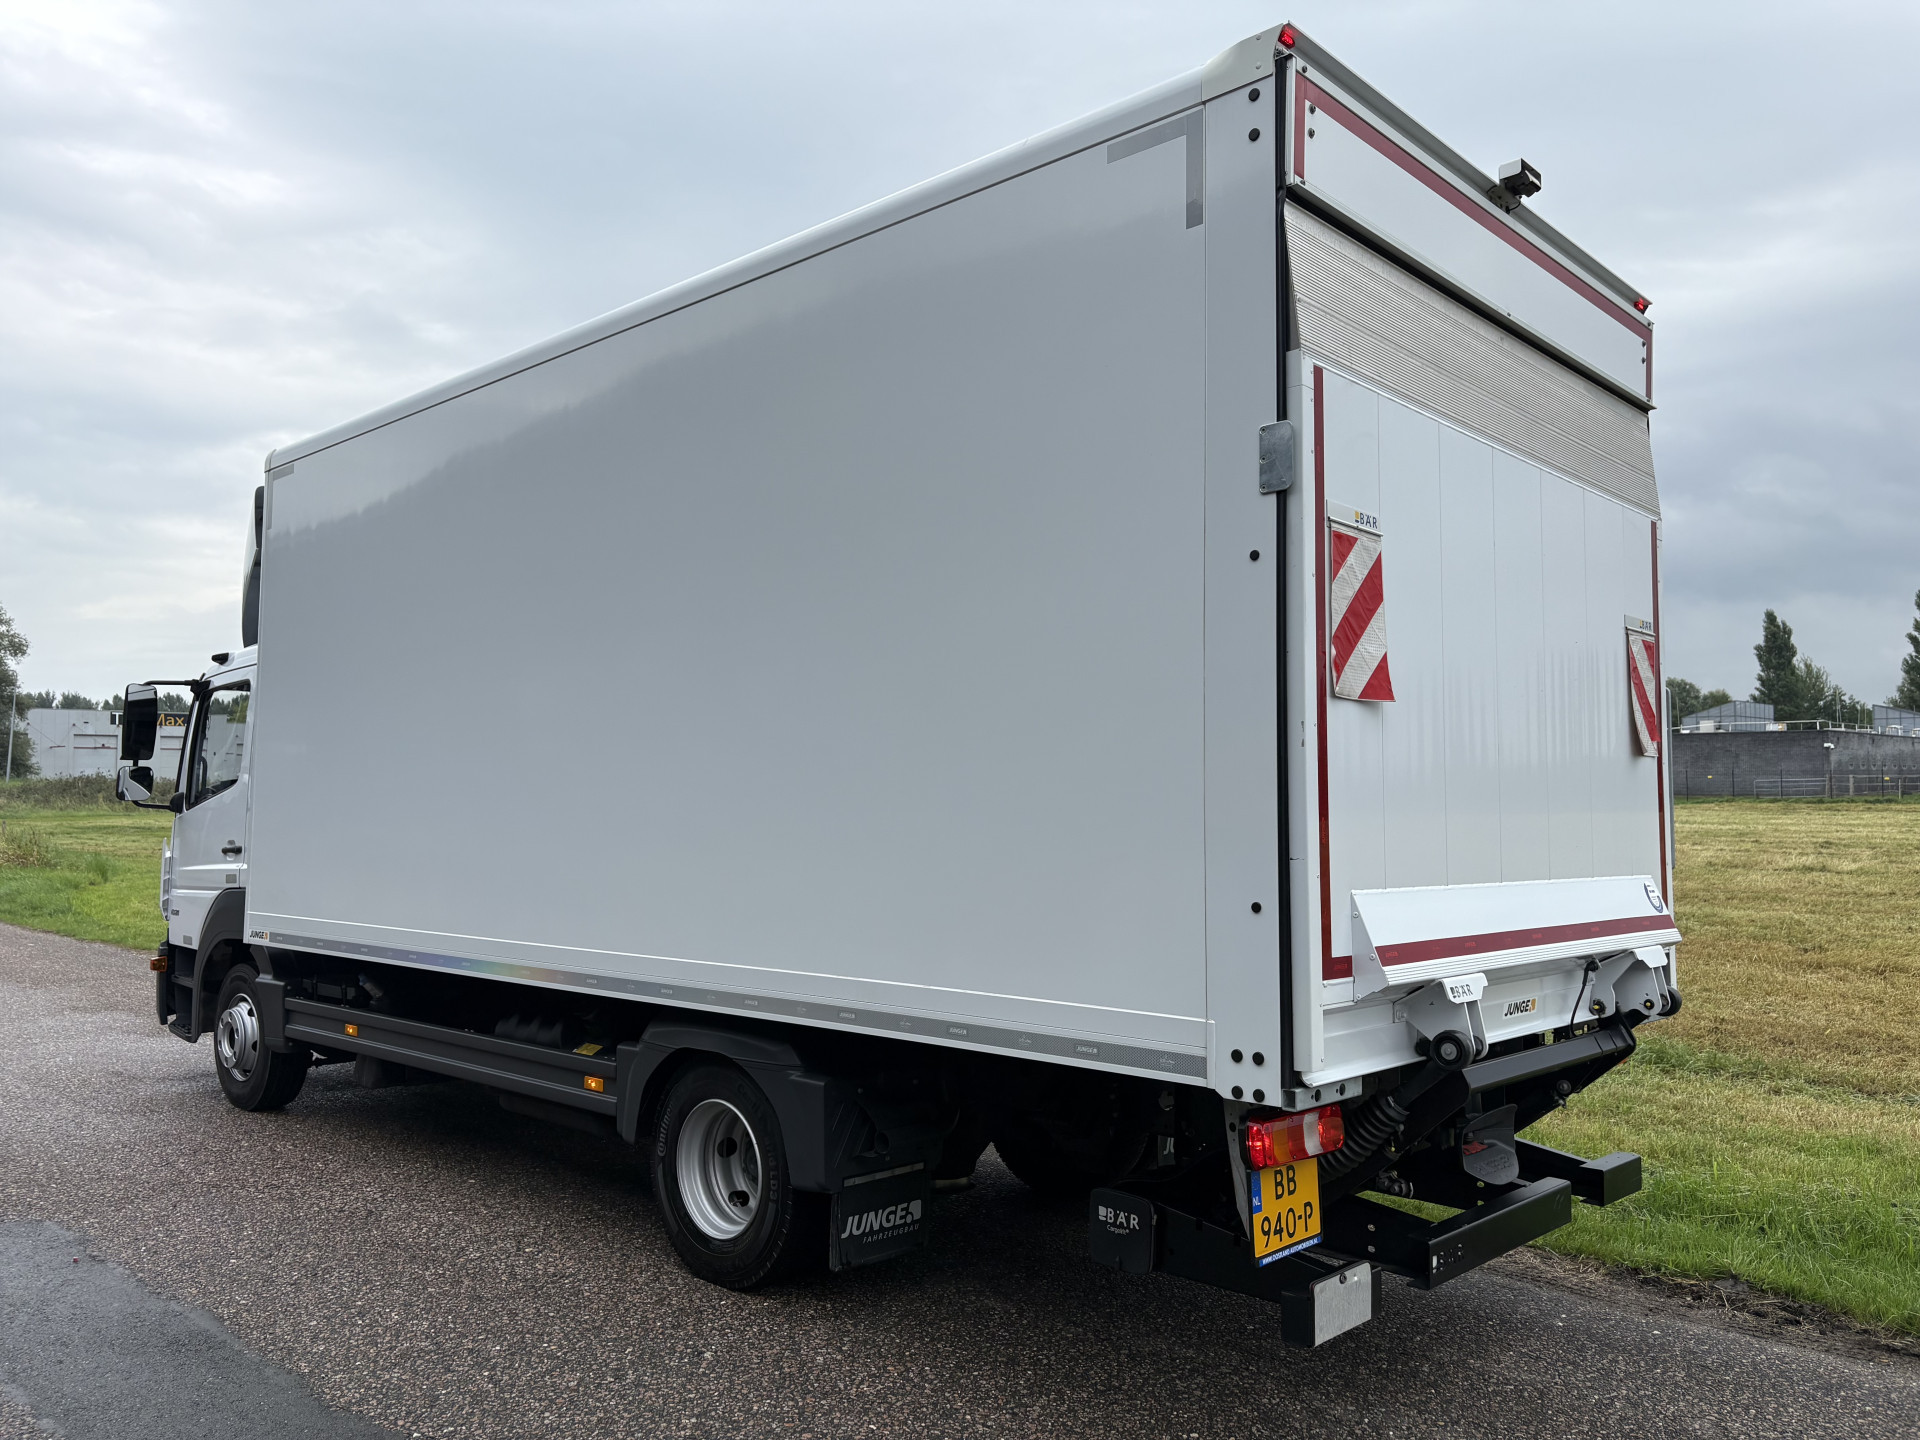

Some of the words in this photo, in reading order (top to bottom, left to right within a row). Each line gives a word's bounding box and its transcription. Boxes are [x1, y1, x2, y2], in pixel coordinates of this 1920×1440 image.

[1359, 512, 1378, 529] BÄR
[1454, 983, 1474, 999] BÄR
[1504, 999, 1531, 1017] JUNGE
[1274, 1164, 1297, 1201] BB
[1252, 1196, 1261, 1207] NL
[841, 1202, 909, 1239] JUNGE
[1107, 1207, 1140, 1230] BÄR
[1260, 1201, 1314, 1249] 940-P
[862, 1223, 920, 1244] FAHRZEUGBAU
